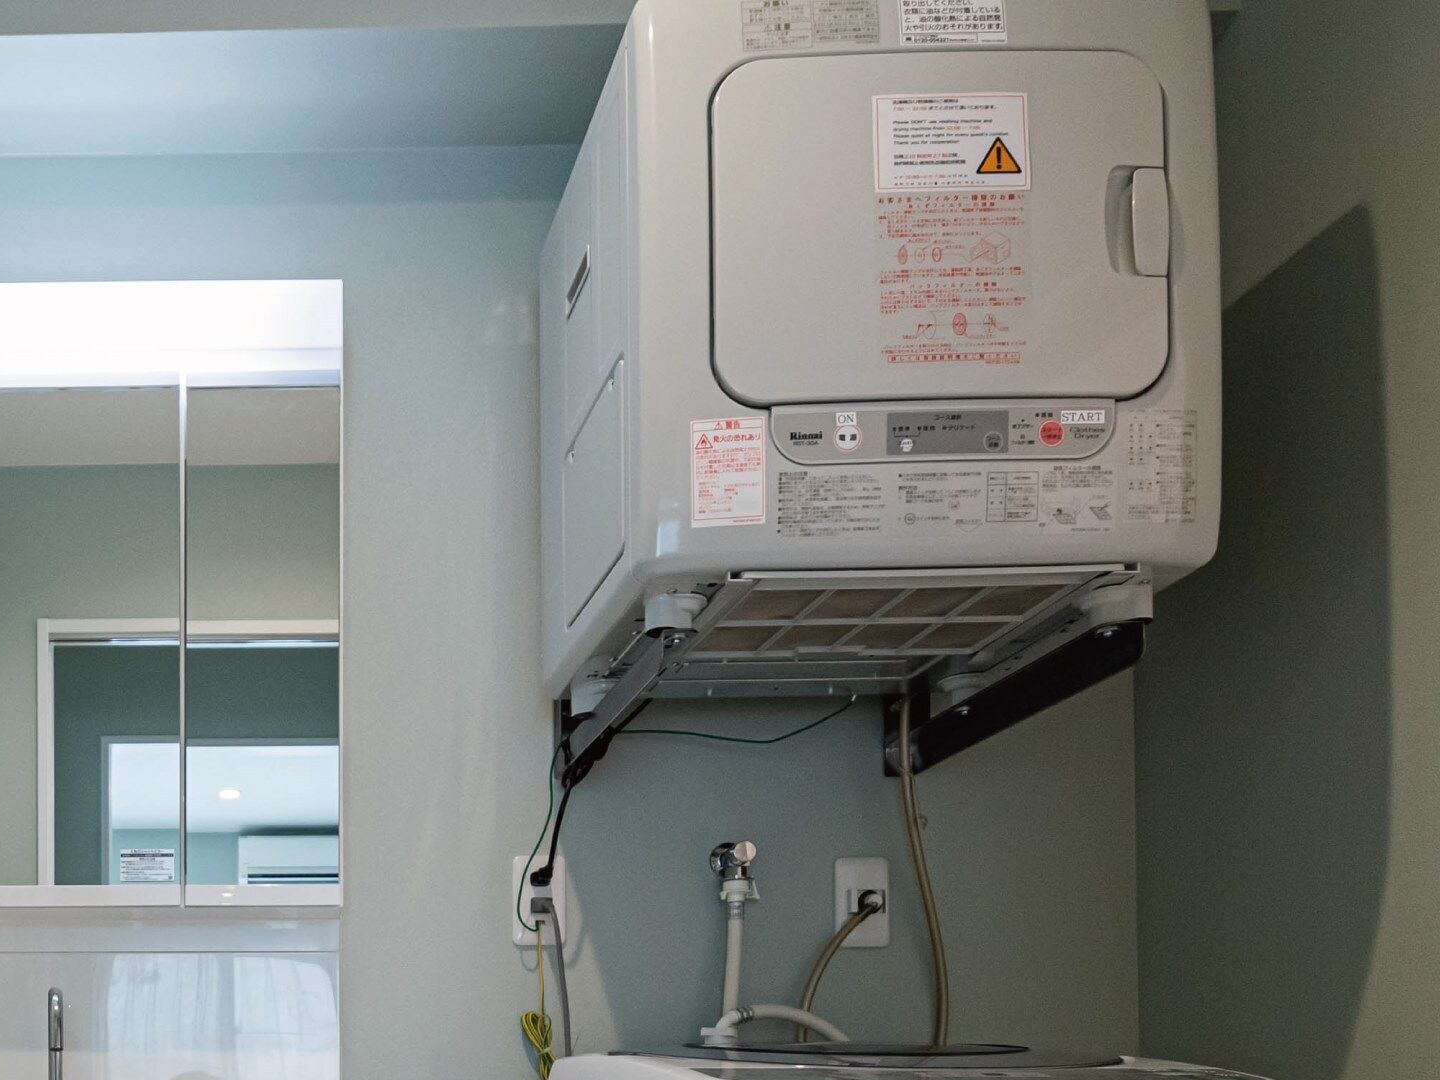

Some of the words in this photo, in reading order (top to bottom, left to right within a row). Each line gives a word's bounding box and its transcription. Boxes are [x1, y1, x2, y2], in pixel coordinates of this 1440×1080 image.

[837, 414, 855, 424] ON
[1062, 411, 1103, 422] START
[790, 431, 823, 441] Rinnai
